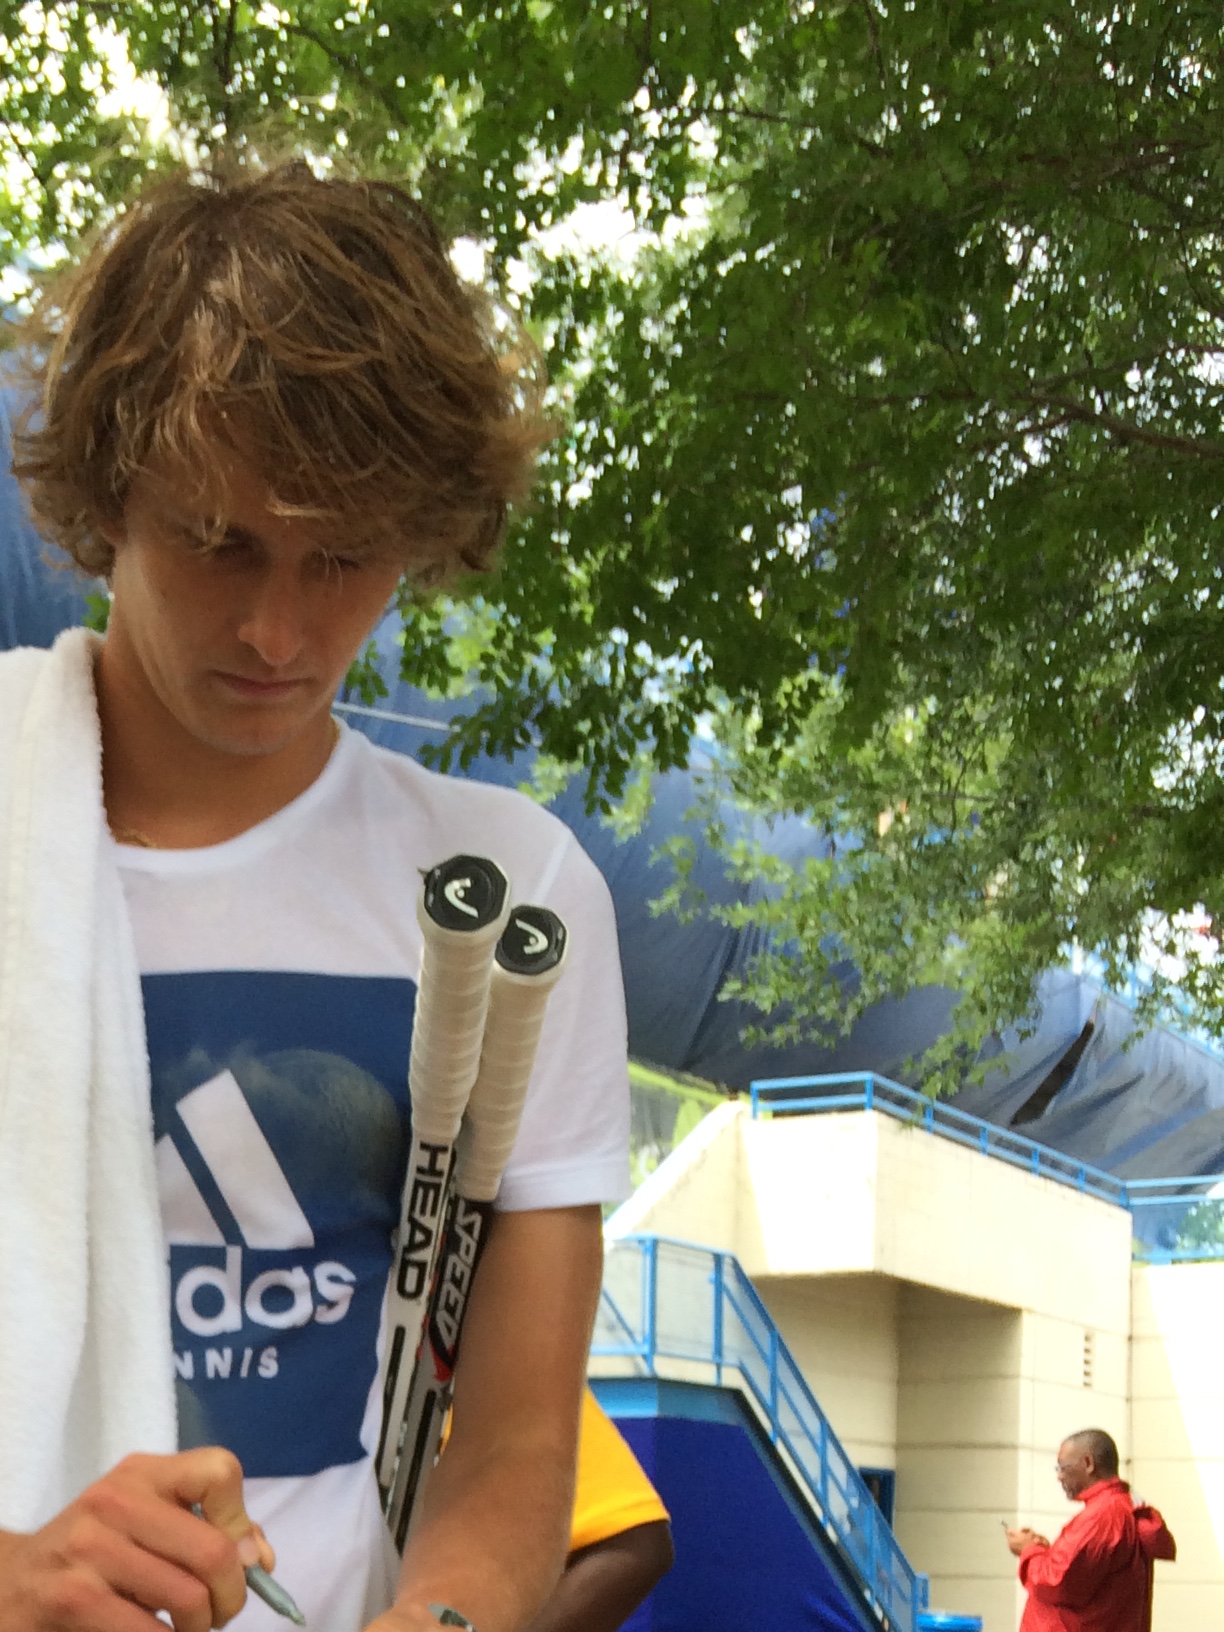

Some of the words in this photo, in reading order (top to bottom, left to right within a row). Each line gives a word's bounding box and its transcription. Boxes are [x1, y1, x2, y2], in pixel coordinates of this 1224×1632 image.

[397, 1142, 449, 1300] HEAD
[436, 1199, 483, 1349] SPEED
[176, 1246, 356, 1336] das
[174, 1347, 278, 1380] NNIS
